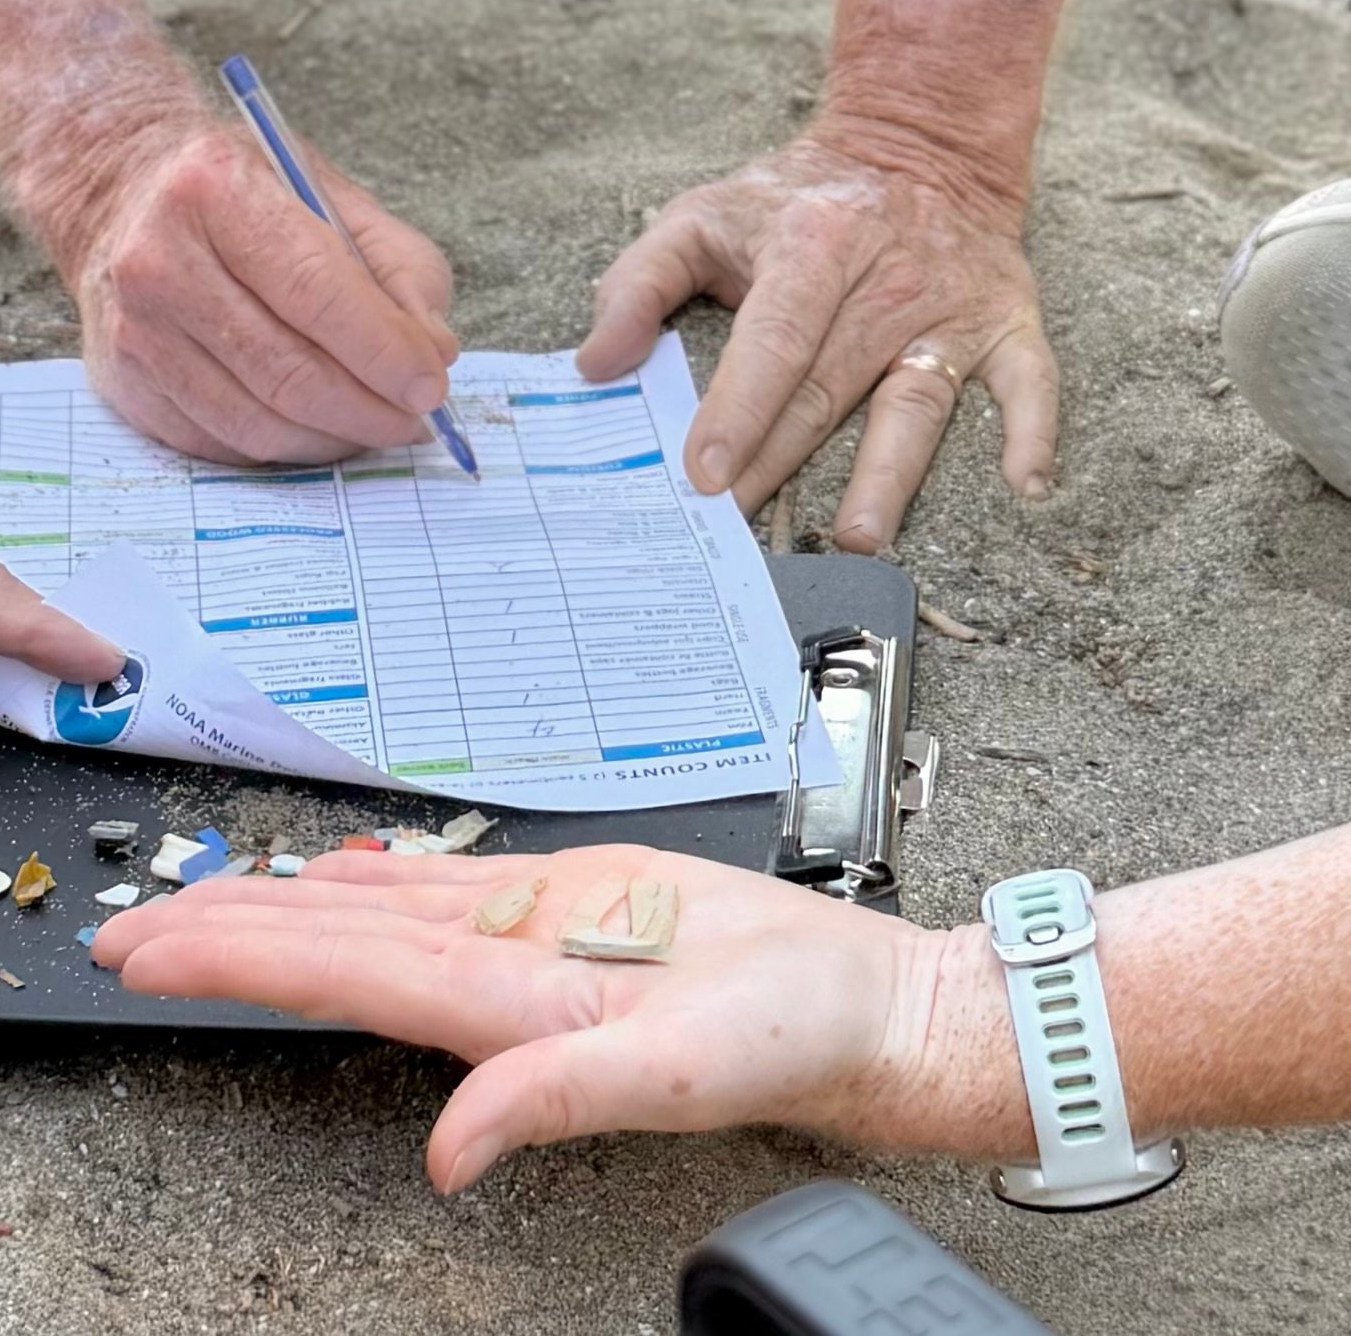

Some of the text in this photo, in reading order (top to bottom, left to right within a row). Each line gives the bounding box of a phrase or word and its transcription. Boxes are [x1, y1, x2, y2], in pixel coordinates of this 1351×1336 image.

[579, 609, 640, 620] containers
[682, 606, 716, 617] Other
[250, 614, 309, 627] RUBBER
[633, 621, 721, 633] Food wrappers
[286, 627, 354, 640] Other glass
[257, 658, 358, 672] Beverage bottles
[633, 663, 734, 679] Beverage bottles
[263, 674, 361, 688] Glass fragments
[710, 676, 739, 687] Bags
[713, 691, 745, 702] Hard
[165, 692, 207, 734] NOAA
[207, 727, 266, 764] Marine
[726, 719, 754, 731] Film
[660, 737, 722, 753] PLASTIC
[715, 751, 773, 770] ITEM
[614, 761, 709, 781] COUNTS
